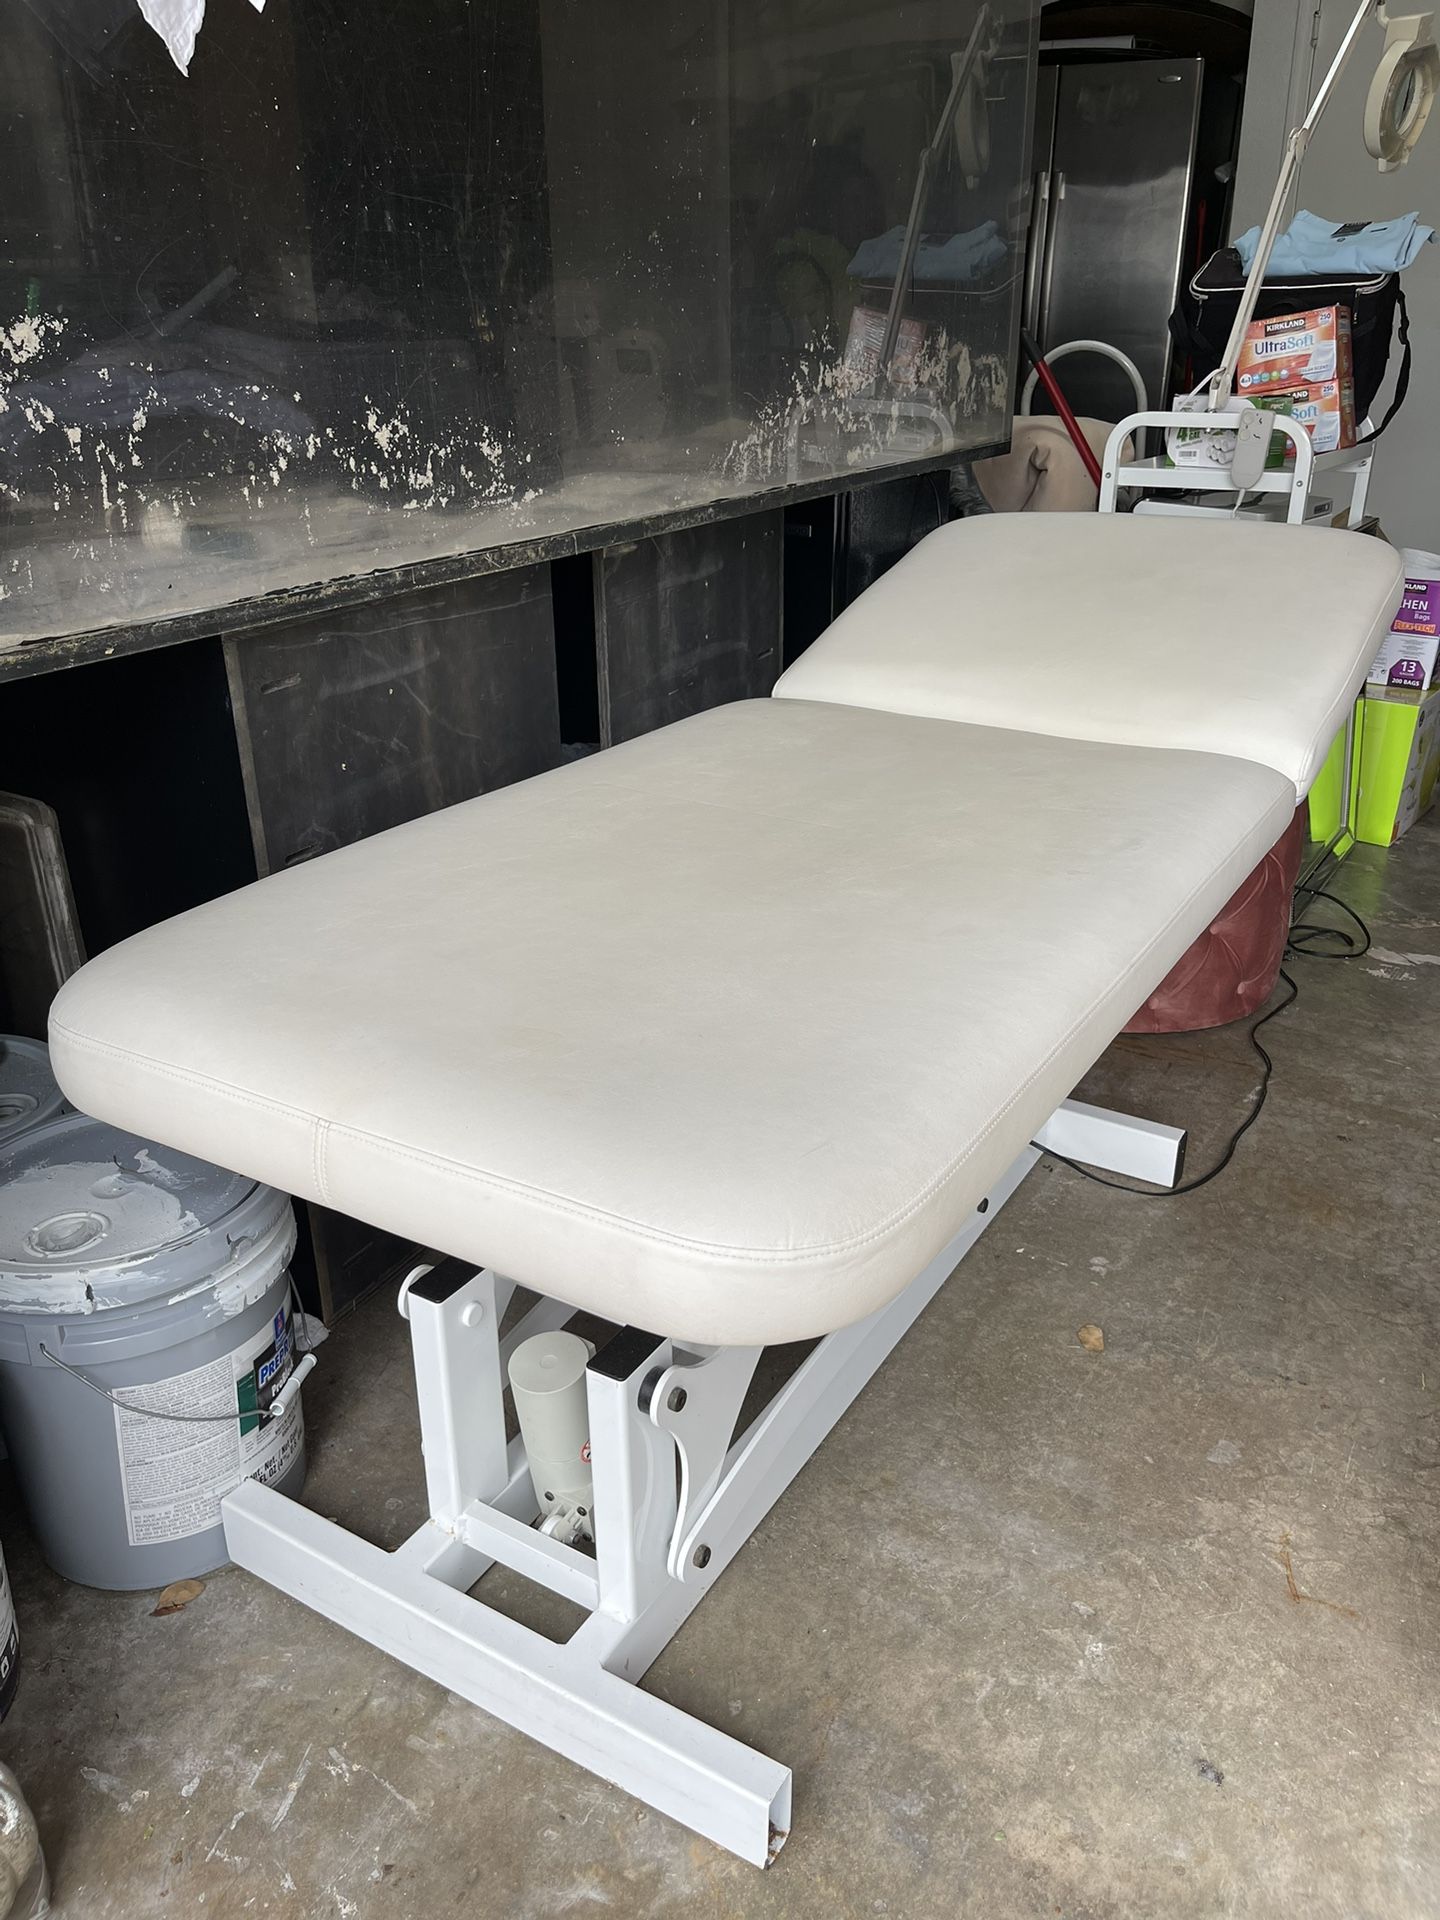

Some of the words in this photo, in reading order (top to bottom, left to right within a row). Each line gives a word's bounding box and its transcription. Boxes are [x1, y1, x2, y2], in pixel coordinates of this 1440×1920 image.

[1266, 319, 1305, 332] KIRKLAND
[1291, 390, 1309, 399] AND
[1405, 583, 1427, 591] KLAND
[1400, 599, 1429, 611] HEN
[1414, 613, 1431, 621] Bags
[1401, 660, 1417, 673] 13
[1391, 677, 1403, 685] 200
[1403, 678, 1420, 687] BAGS
[259, 1340, 289, 1386] PREPR
